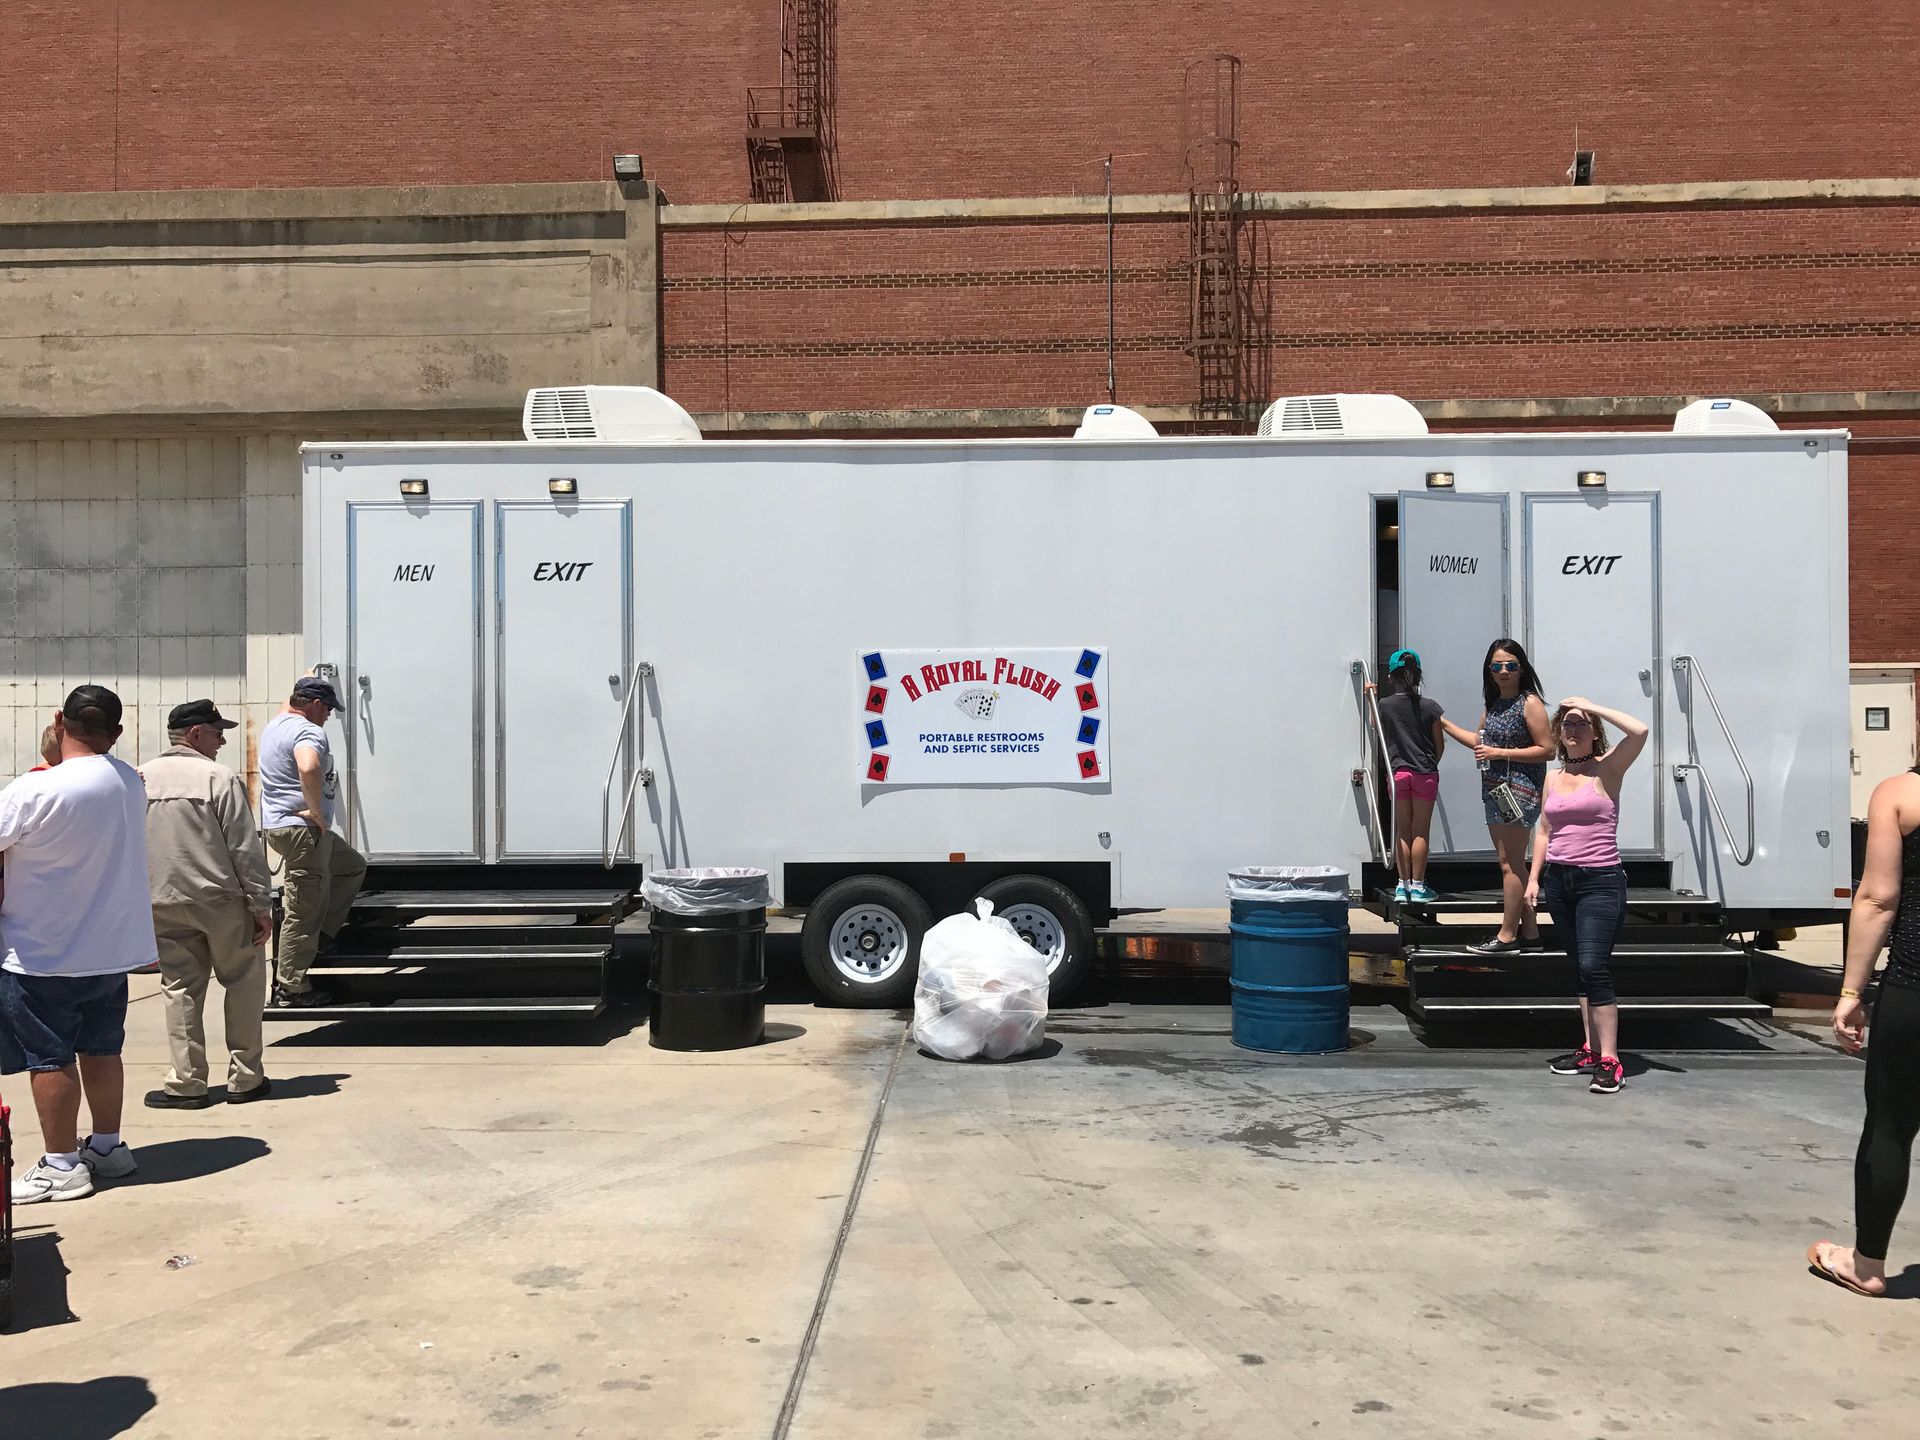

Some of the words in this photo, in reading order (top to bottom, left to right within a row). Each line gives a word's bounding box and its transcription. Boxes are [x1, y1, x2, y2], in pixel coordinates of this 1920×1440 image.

[393, 563, 436, 583] MEN
[532, 561, 594, 582] EXIT
[1428, 553, 1479, 575] WOMEN
[1561, 554, 1623, 576] EXIT
[900, 674, 923, 702] A
[919, 733, 974, 743] PORTABLE
[977, 732, 1045, 742] RESTROOMS
[924, 744, 949, 754] AND
[952, 744, 987, 754] SEPTIC
[990, 743, 1040, 753] SERVICES
